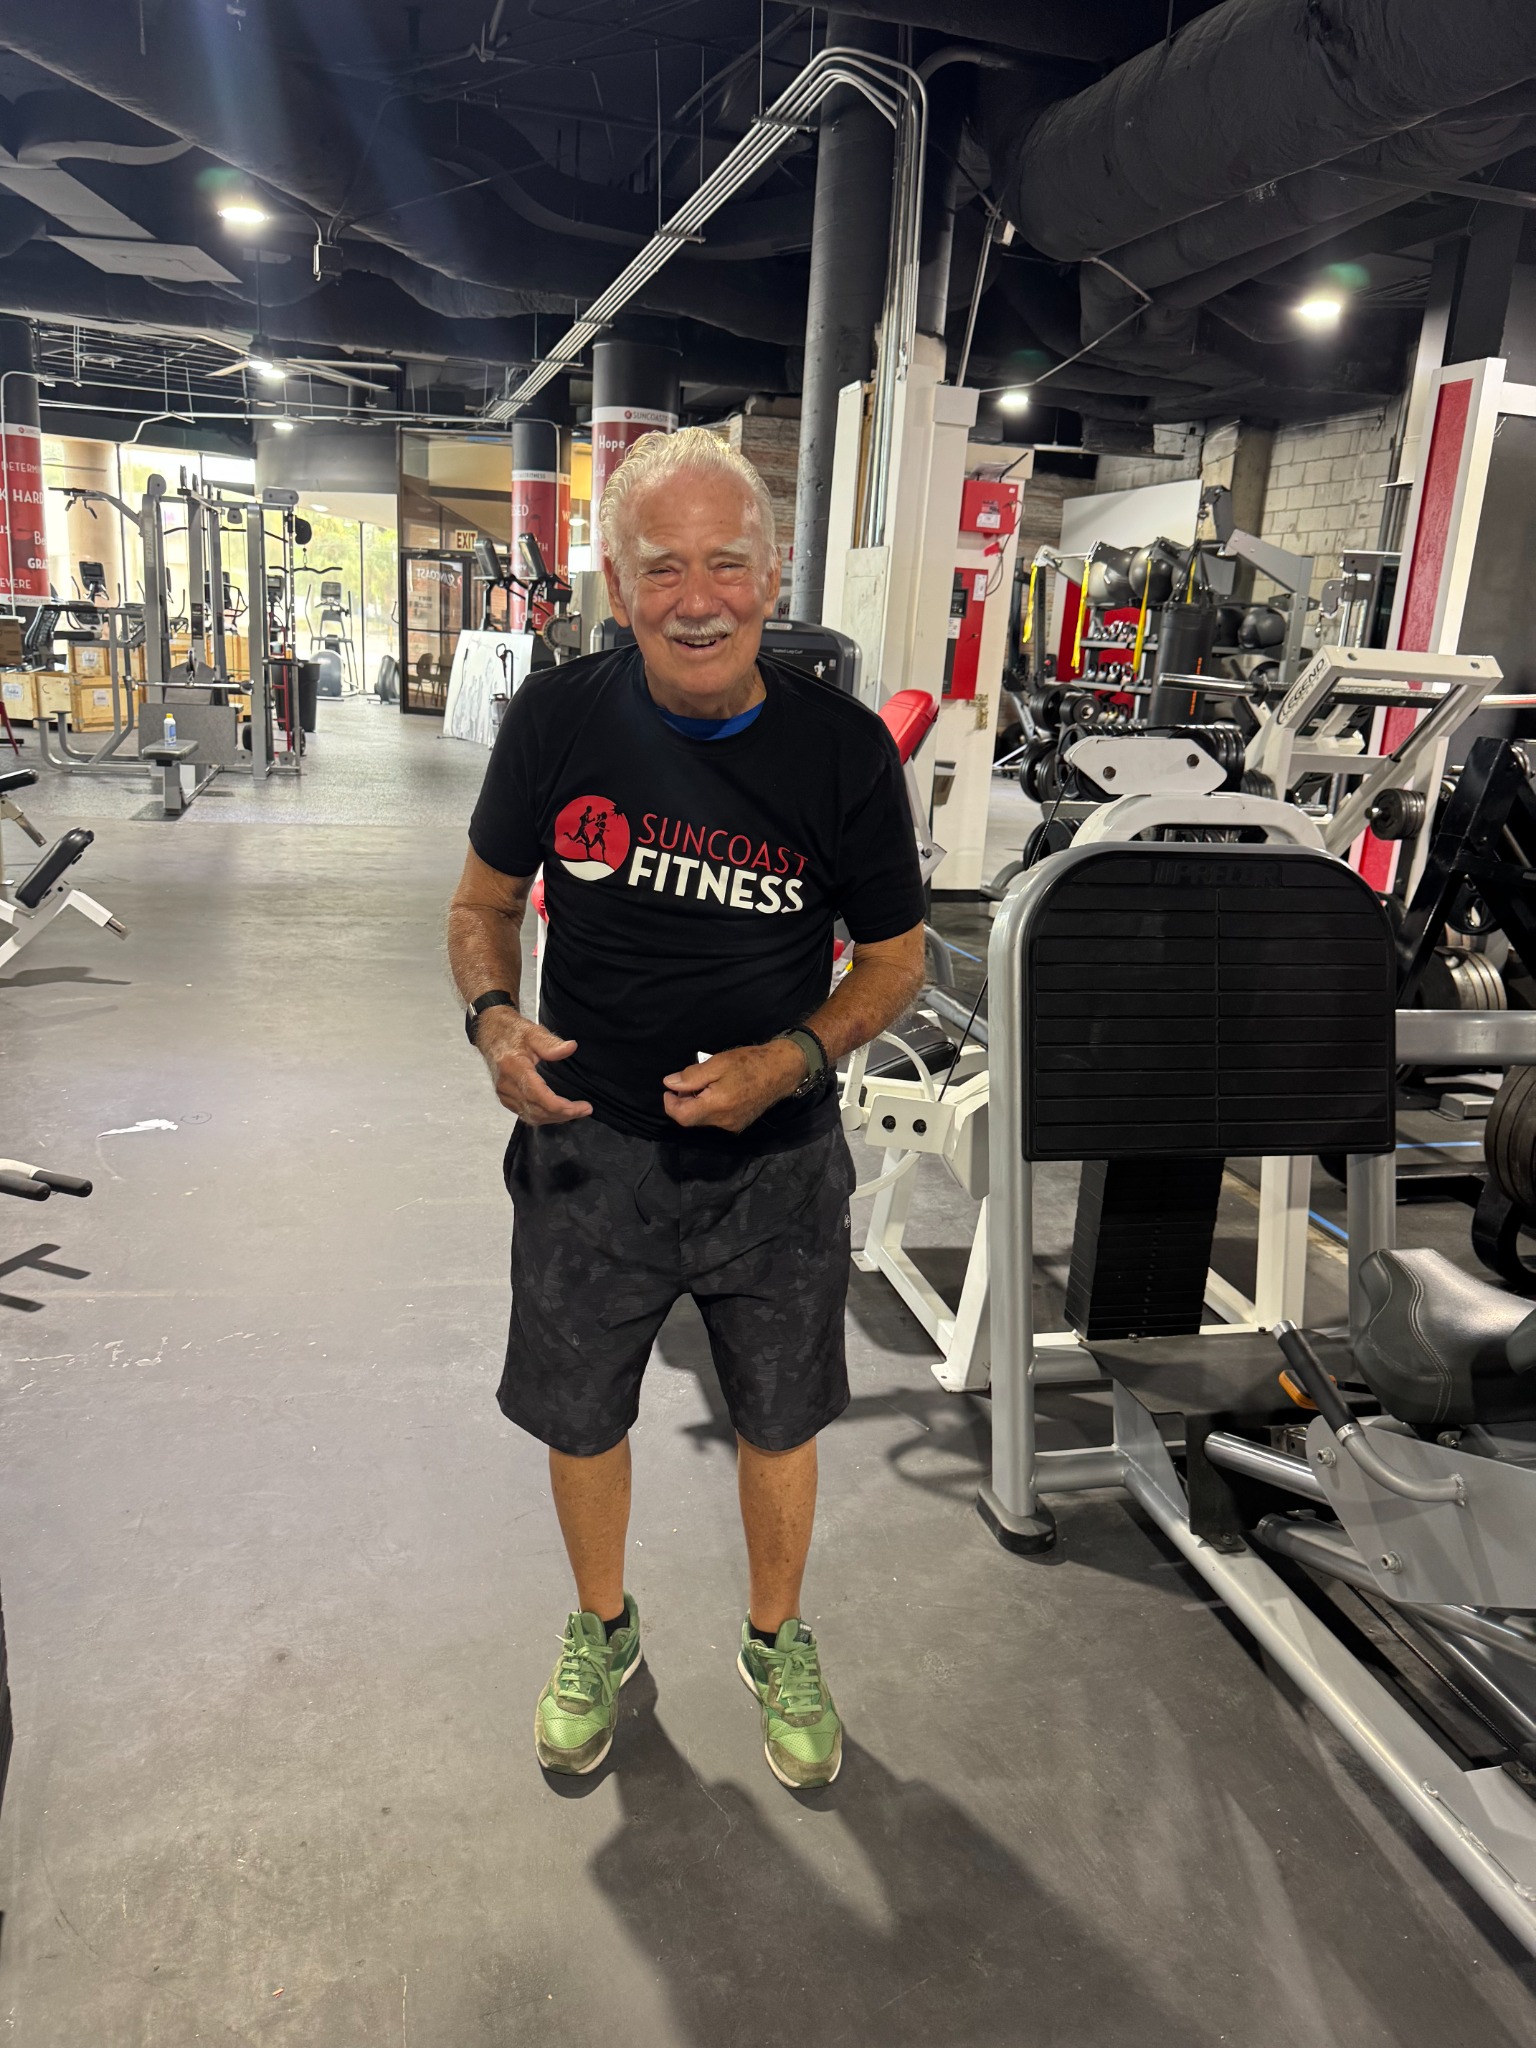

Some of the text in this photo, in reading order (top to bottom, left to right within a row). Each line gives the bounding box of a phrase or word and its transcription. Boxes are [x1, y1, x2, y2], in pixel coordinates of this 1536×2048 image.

[598, 435, 625, 452] Hope
[456, 532, 476, 549] EXIT
[516, 612, 541, 625] LOE
[1282, 658, 1325, 716] LEGEND
[638, 813, 809, 876] SUNCOAST
[627, 846, 804, 914] FITNESS
